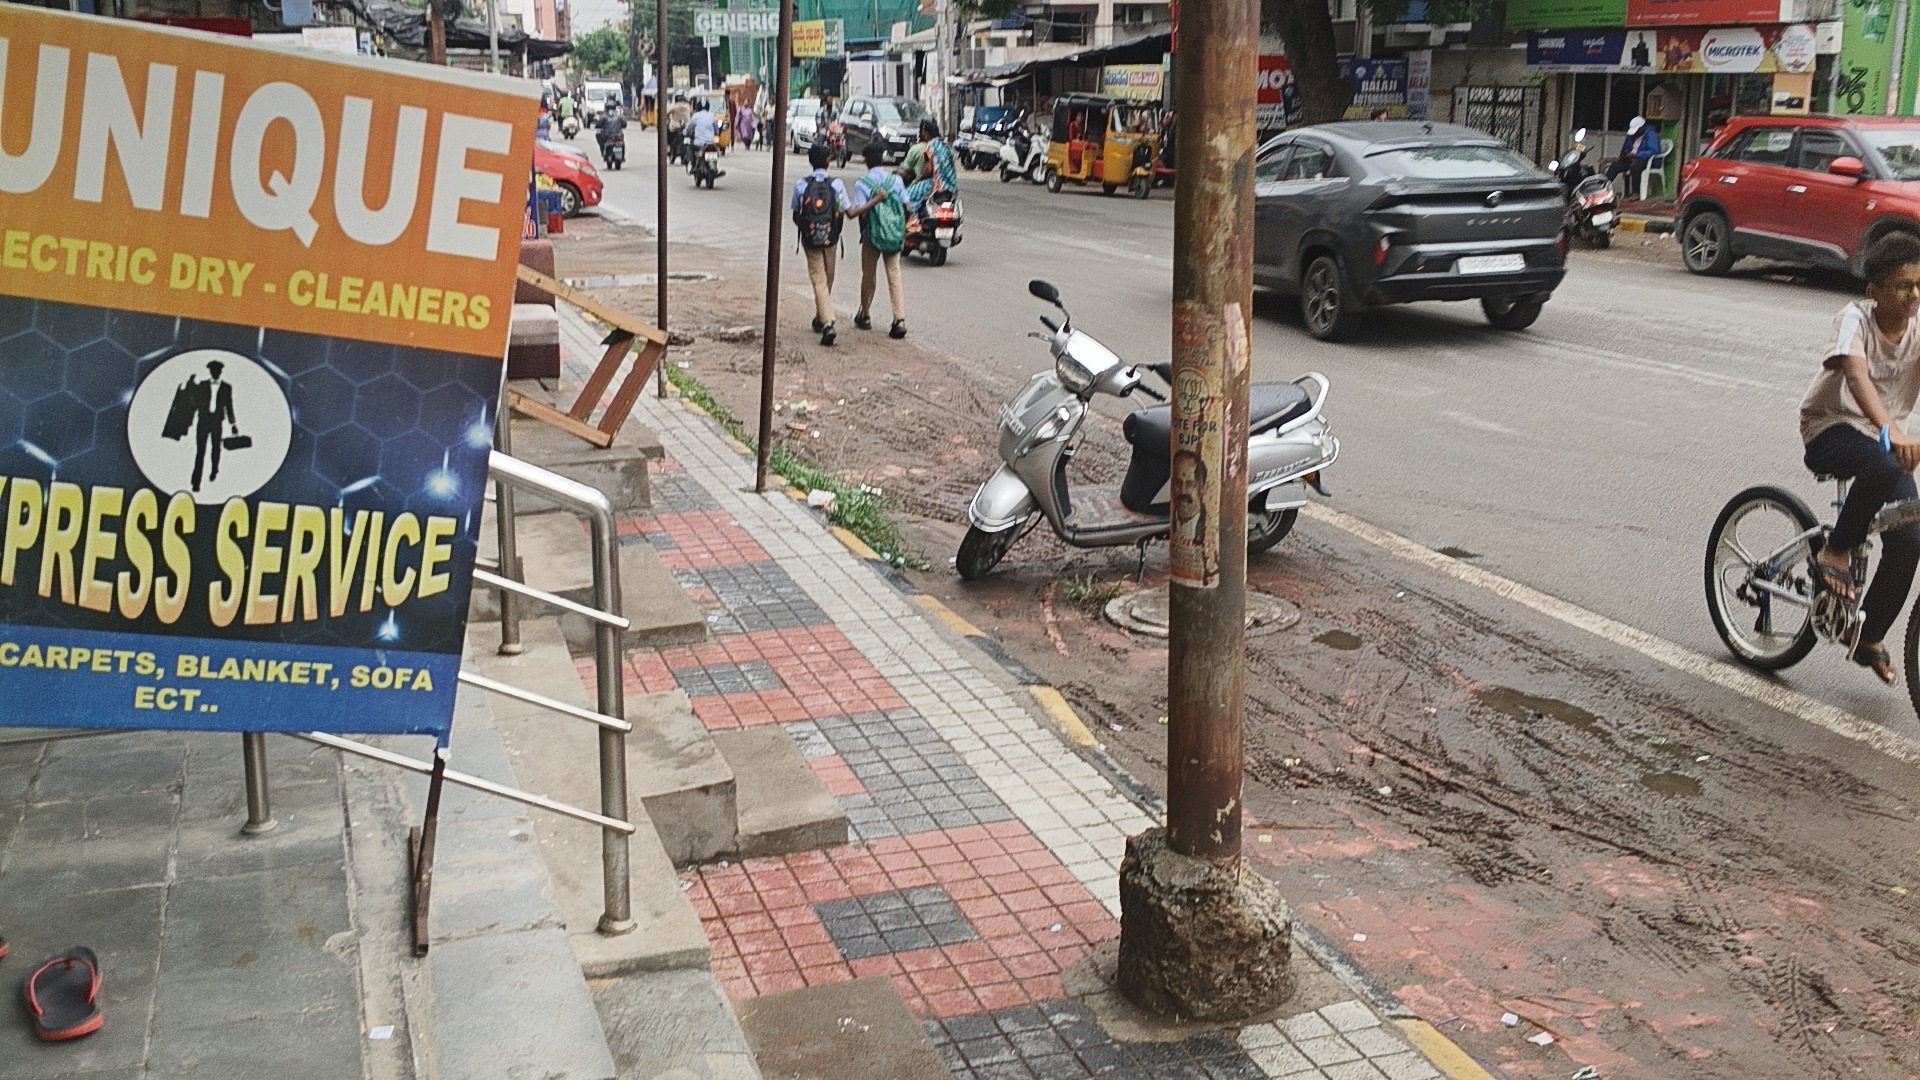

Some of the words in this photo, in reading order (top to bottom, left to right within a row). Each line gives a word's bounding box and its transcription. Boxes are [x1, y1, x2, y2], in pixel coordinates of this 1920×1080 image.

[696, 12, 779, 32] GENERIC
[1708, 45, 1761, 57] MICROTEK
[0, 37, 513, 262] UNIQUE
[0, 229, 157, 286] ECTRIC
[170, 252, 255, 297] DRY
[288, 269, 491, 330] CLEANERS
[1178, 433, 1198, 445] BJP
[1193, 420, 1217, 432] FOR
[0, 475, 196, 625] PRESS
[208, 495, 456, 628] SERVICE
[0, 642, 164, 681] CARPETS,
[177, 656, 340, 692] BLANKET,
[351, 665, 434, 692] SOFA
[134, 686, 219, 713] ECT..
